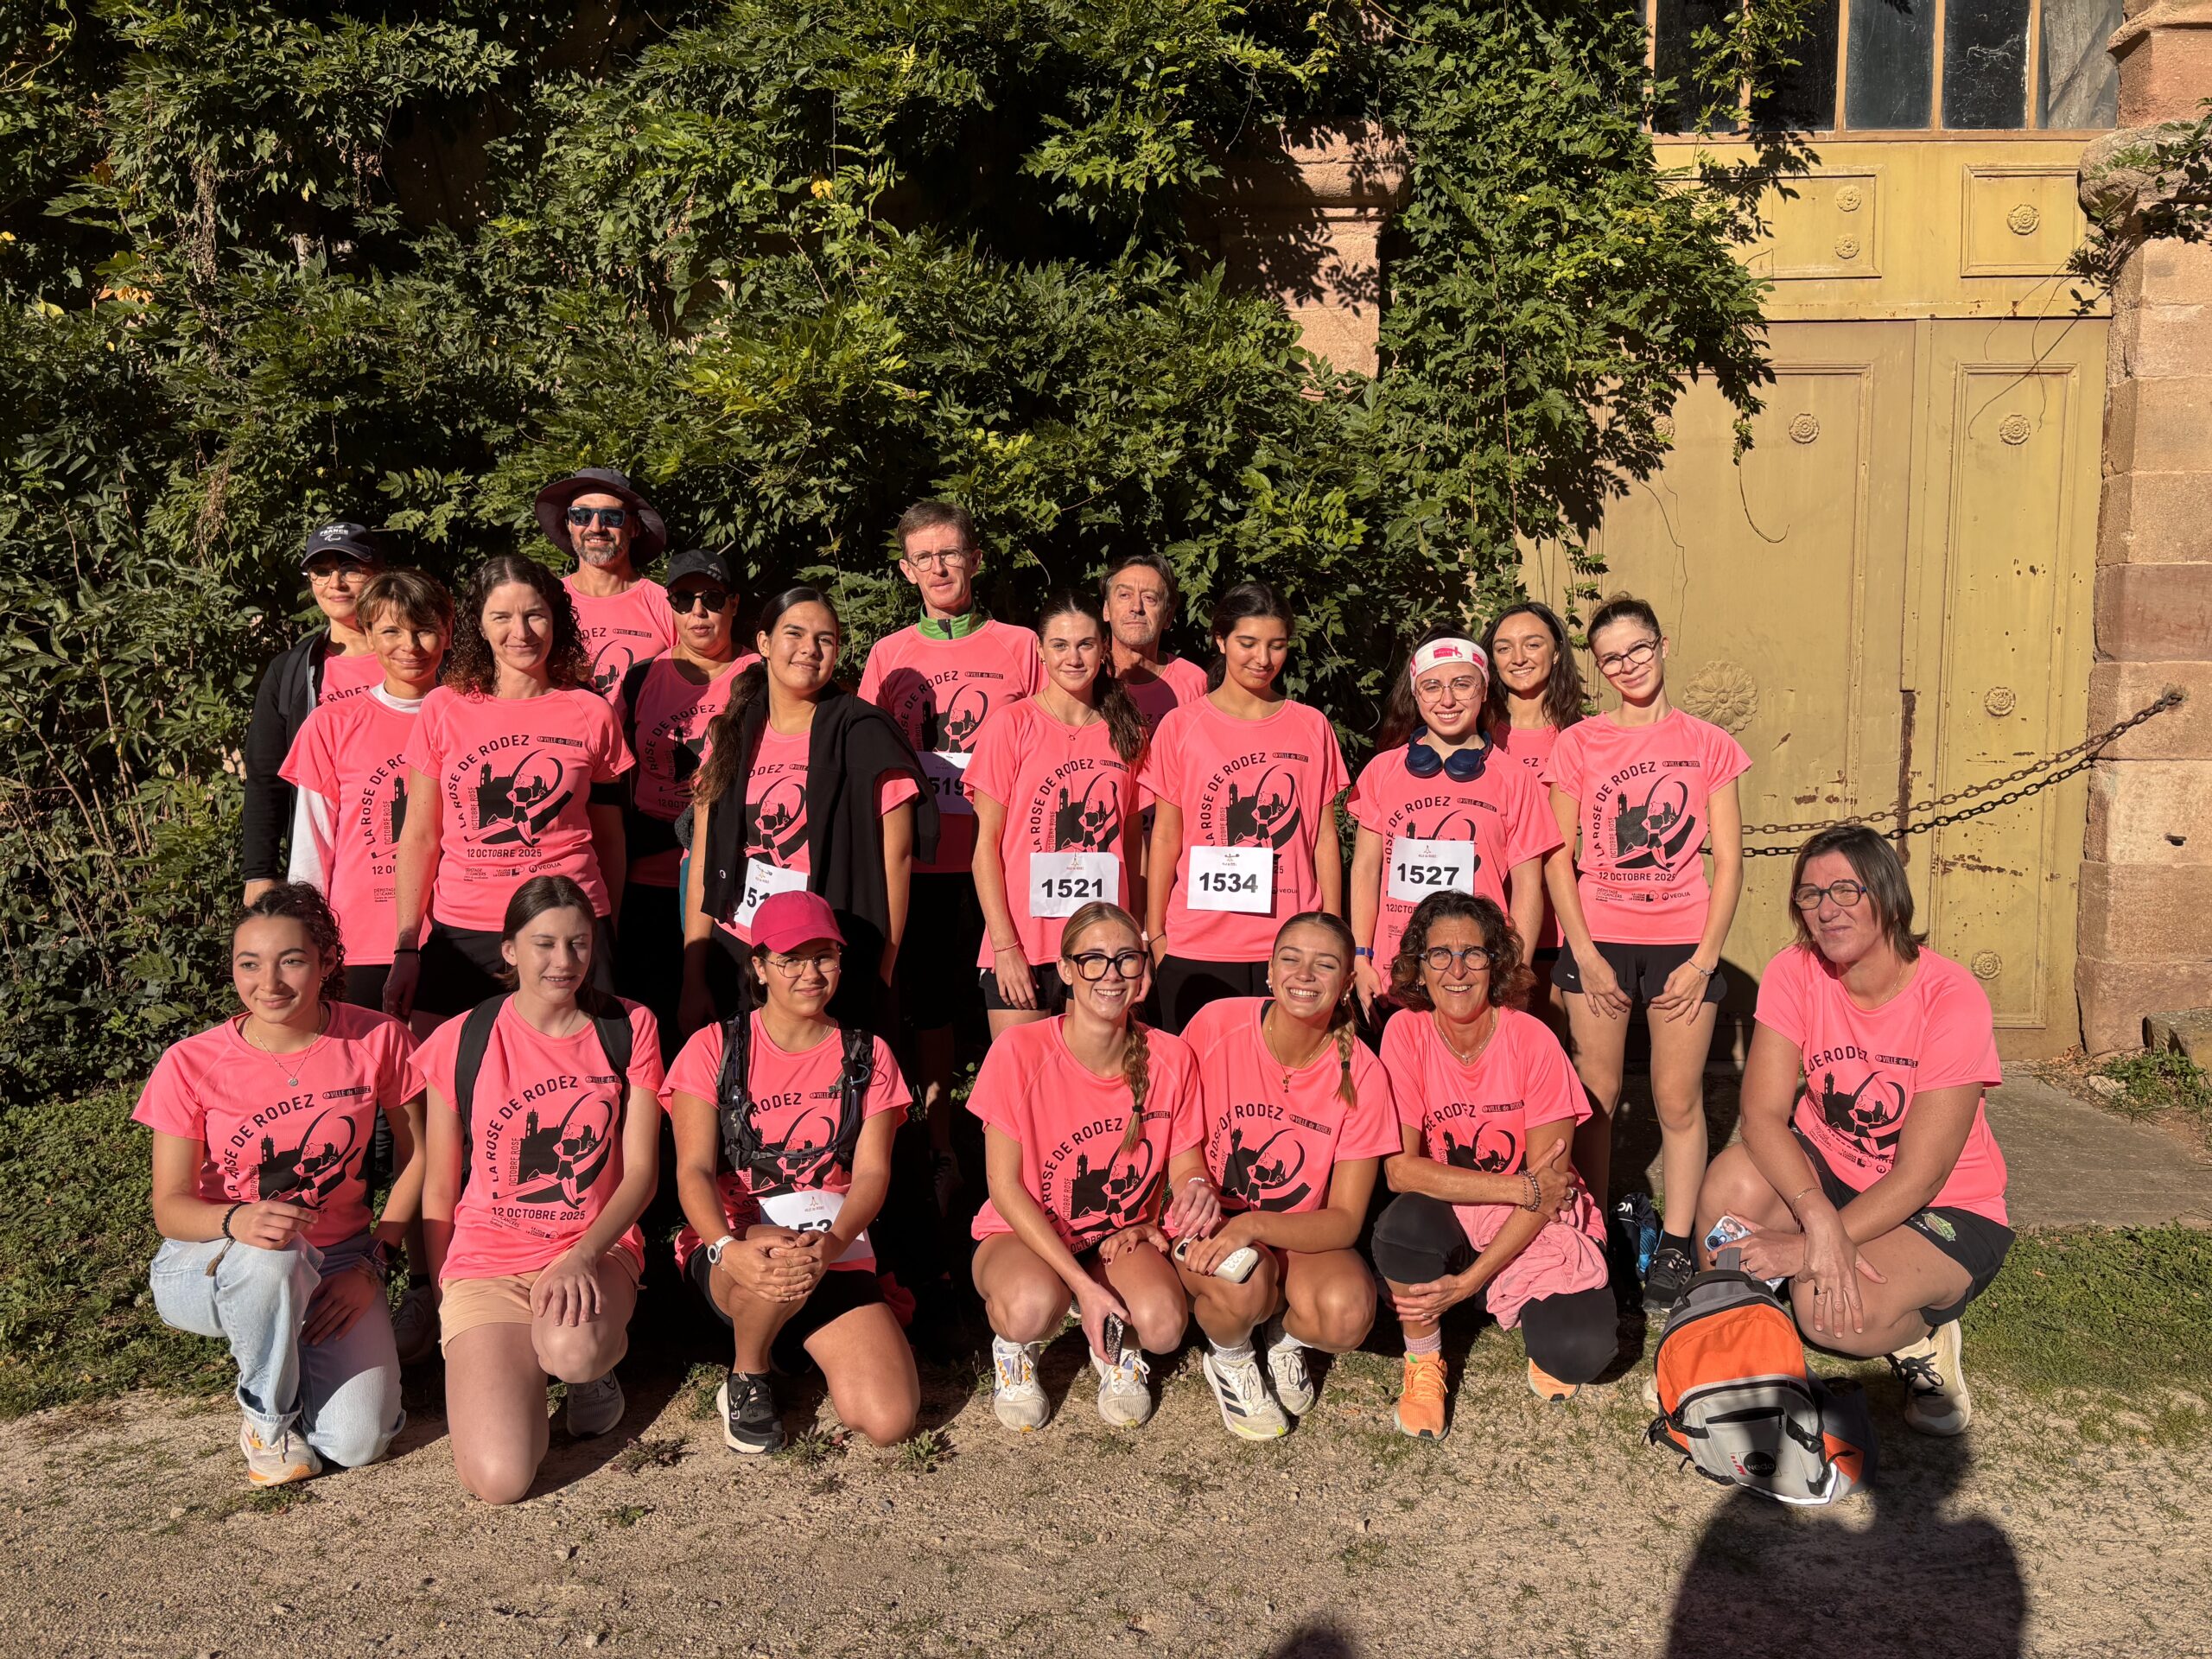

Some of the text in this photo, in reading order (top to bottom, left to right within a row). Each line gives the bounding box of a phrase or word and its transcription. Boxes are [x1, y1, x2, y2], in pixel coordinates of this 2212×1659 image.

[582, 627, 607, 639] DEZ
[904, 693, 919, 710] DE
[918, 671, 958, 693] RODEZ
[645, 740, 658, 771] ROSE
[652, 721, 670, 737] DE
[671, 704, 715, 722] RODEZ
[448, 734, 530, 829] LA ROSE DE RODEZ
[749, 764, 785, 778] ODEZ
[1030, 798, 1046, 835] ROSE
[1039, 777, 1056, 795] DE
[1054, 759, 1094, 779] RODEZ
[1200, 793, 1214, 830] ROSE
[1208, 773, 1224, 791] DE
[1223, 752, 1267, 776] RODEZ
[361, 767, 389, 845] LA ROSE DE
[1389, 810, 1403, 828] DE
[1405, 797, 1451, 814] RODEZ
[1593, 761, 1656, 857] LA ROSE DE RODEZ
[467, 849, 542, 857] 12 OCTOBRE 2025
[372, 866, 384, 874] 12
[1397, 862, 1459, 886] 1527
[1611, 873, 1650, 881] OCTOBRE
[1655, 873, 1676, 881] 2025
[1042, 878, 1103, 899] 1521
[1199, 873, 1258, 893] 1534
[1386, 904, 1395, 912] 12
[1809, 1046, 1868, 1071] DE RODEZ
[1882, 1056, 1897, 1065] VILLE
[330, 1090, 346, 1098] VILLE
[752, 1092, 802, 1117] RODEZ
[252, 1094, 315, 1128] RODEZ
[1235, 1103, 1284, 1122] RODEZ
[231, 1125, 254, 1147] DE
[486, 1076, 579, 1182] LA ROSE DE RODEZ
[1296, 1116, 1307, 1127] VILLE
[1315, 1123, 1331, 1135] RODEZ
[1042, 1118, 1123, 1224] LA ROSE DE RODEZ
[227, 1185, 242, 1198] LA
[492, 1207, 586, 1220] 12 OCTOBRE 2025
